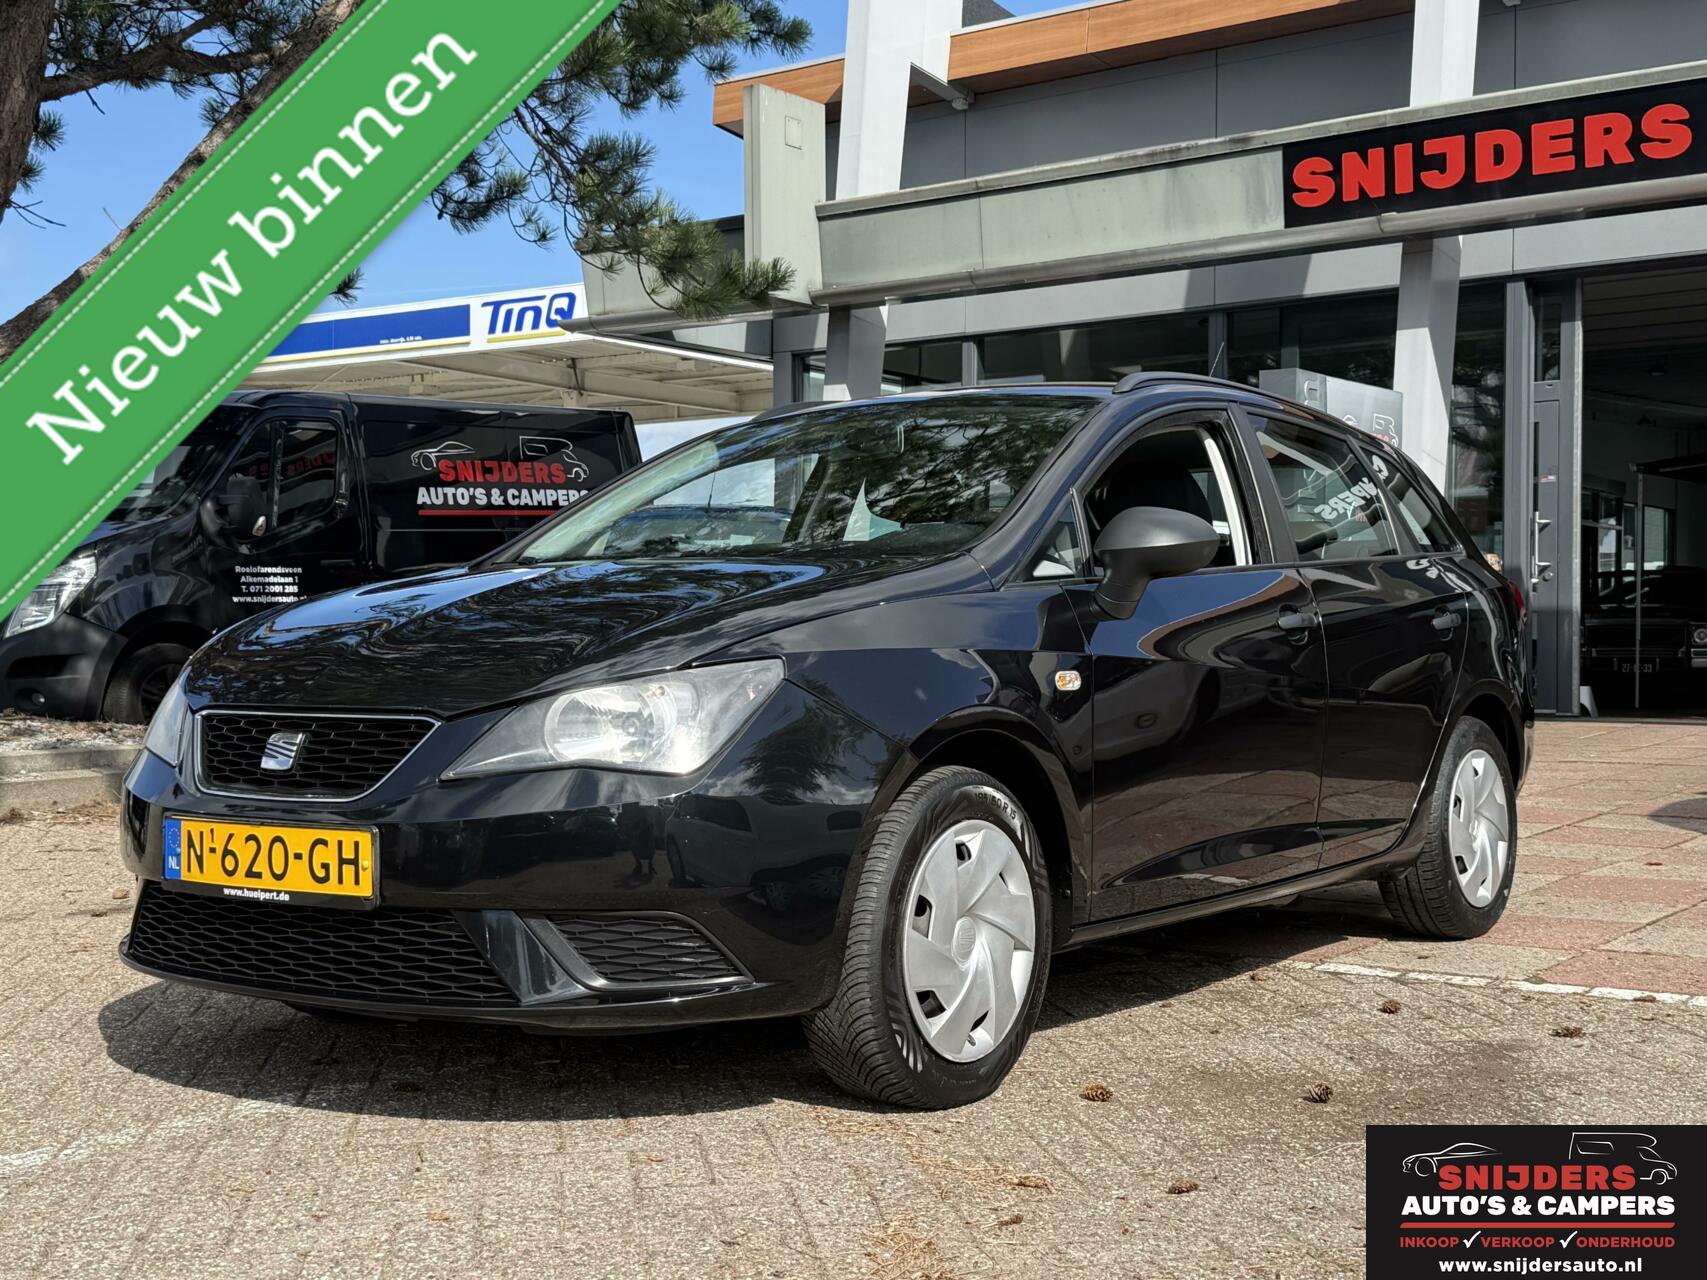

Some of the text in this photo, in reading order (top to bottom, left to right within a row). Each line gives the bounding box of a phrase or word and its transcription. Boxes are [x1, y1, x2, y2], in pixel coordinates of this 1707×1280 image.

[1292, 103, 1694, 208] SNIJDERS
[481, 291, 577, 335] TinQ
[437, 458, 568, 484] SNIJDERS
[416, 486, 487, 506] AUTO'S
[491, 488, 505, 506] &
[232, 595, 307, 603] www.snijdersauto
[249, 585, 264, 593] 071
[264, 585, 283, 593] 2001
[284, 585, 299, 593] 285
[168, 855, 180, 870] NL
[186, 829, 361, 886] N-620-GH
[223, 887, 290, 901] www.huelpert.de
